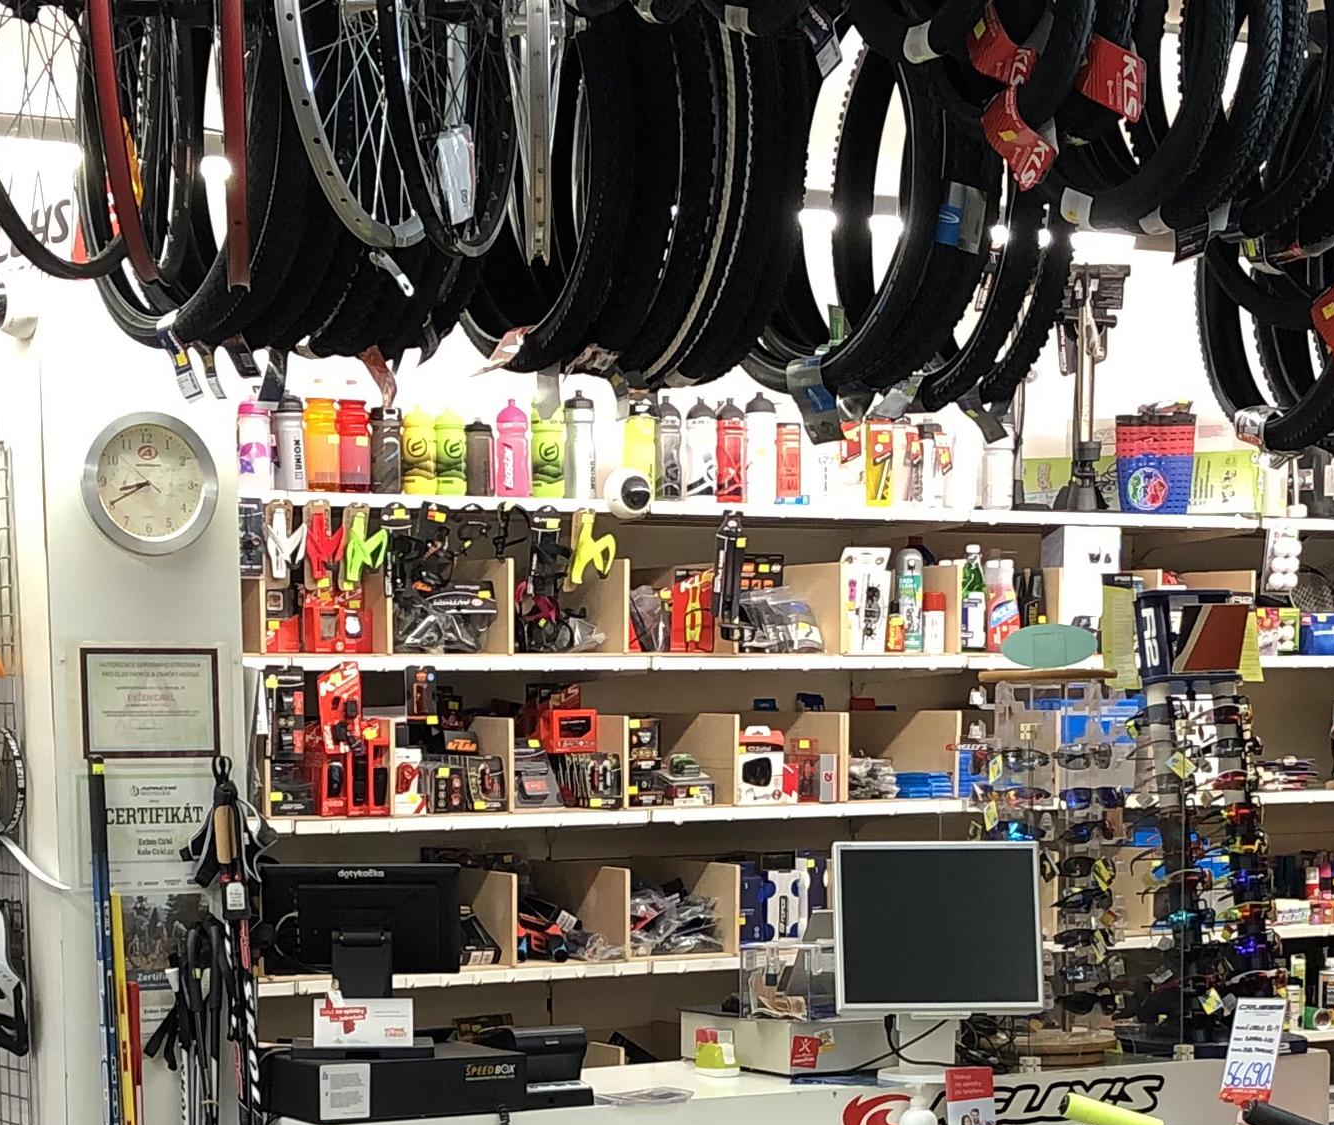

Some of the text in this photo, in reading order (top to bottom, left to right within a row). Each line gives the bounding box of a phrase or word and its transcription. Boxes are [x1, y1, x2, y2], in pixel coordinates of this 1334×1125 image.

[1122, 54, 1138, 119] KLS
[1020, 139, 1050, 190] KLS
[140, 433, 153, 444] 12
[107, 456, 118, 466] 10
[294, 439, 303, 472] UNION
[179, 456, 186, 467] 2
[188, 479, 195, 489] 3
[145, 523, 153, 534] 6
[1141, 606, 1161, 668] R2
[106, 802, 204, 826] CERTIFIKÁT
[337, 868, 385, 880] dotykačka
[137, 971, 168, 982] Zertifi
